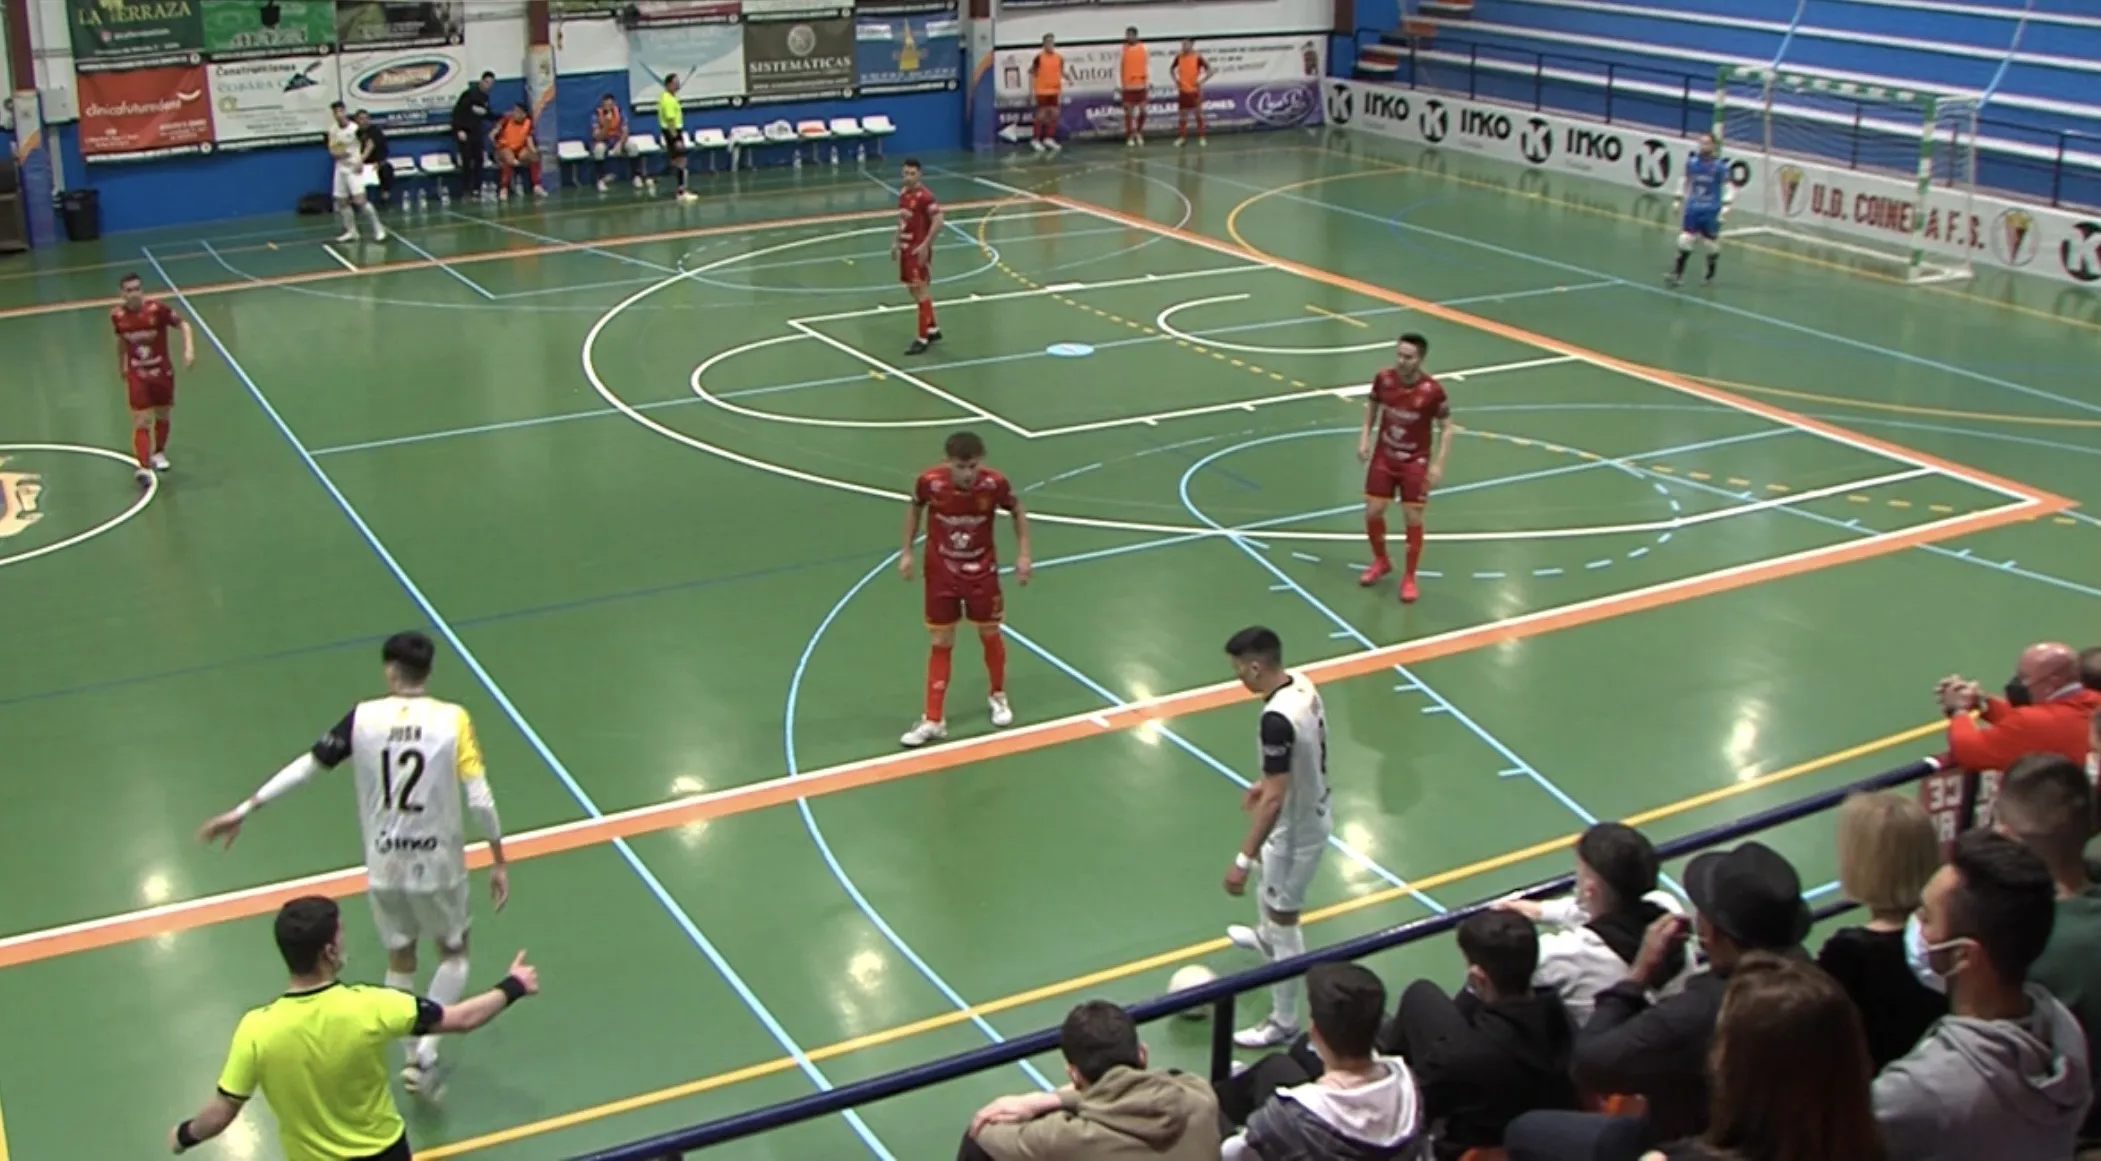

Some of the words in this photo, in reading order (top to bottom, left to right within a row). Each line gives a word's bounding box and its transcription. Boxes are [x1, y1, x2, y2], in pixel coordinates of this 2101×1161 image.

[79, 8, 102, 25] LA
[1811, 183, 1848, 221] U.D.
[382, 748, 425, 813] 12
